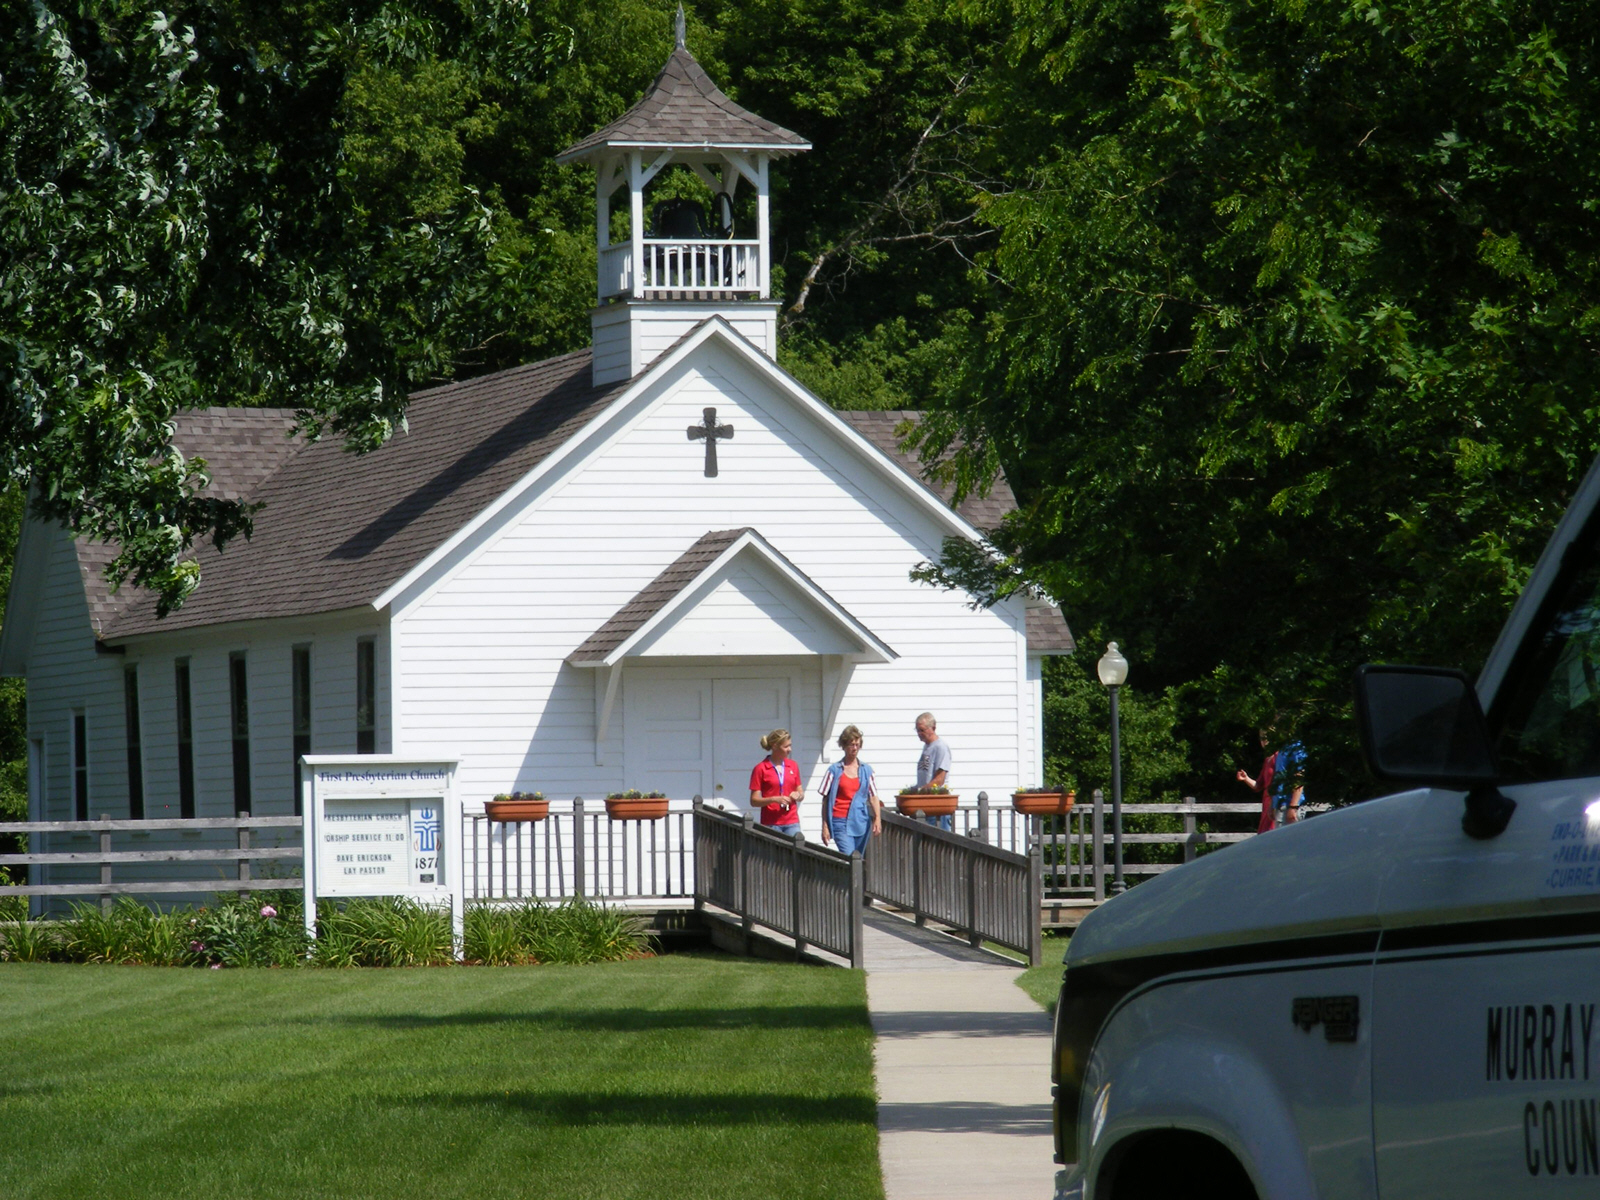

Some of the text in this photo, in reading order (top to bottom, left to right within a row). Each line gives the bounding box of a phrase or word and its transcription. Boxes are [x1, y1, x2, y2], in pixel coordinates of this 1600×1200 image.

[320, 769, 445, 784] First Presbyterian Church
[376, 813, 402, 822] CHURCH
[324, 834, 349, 843] ORSHIP
[352, 833, 381, 843] SERVICE
[336, 854, 392, 862] DAVE ERICKSON
[343, 866, 385, 875] LAY PASTOR
[1486, 1003, 1595, 1081] MURRAY
[1524, 1098, 1600, 1177] COUN
